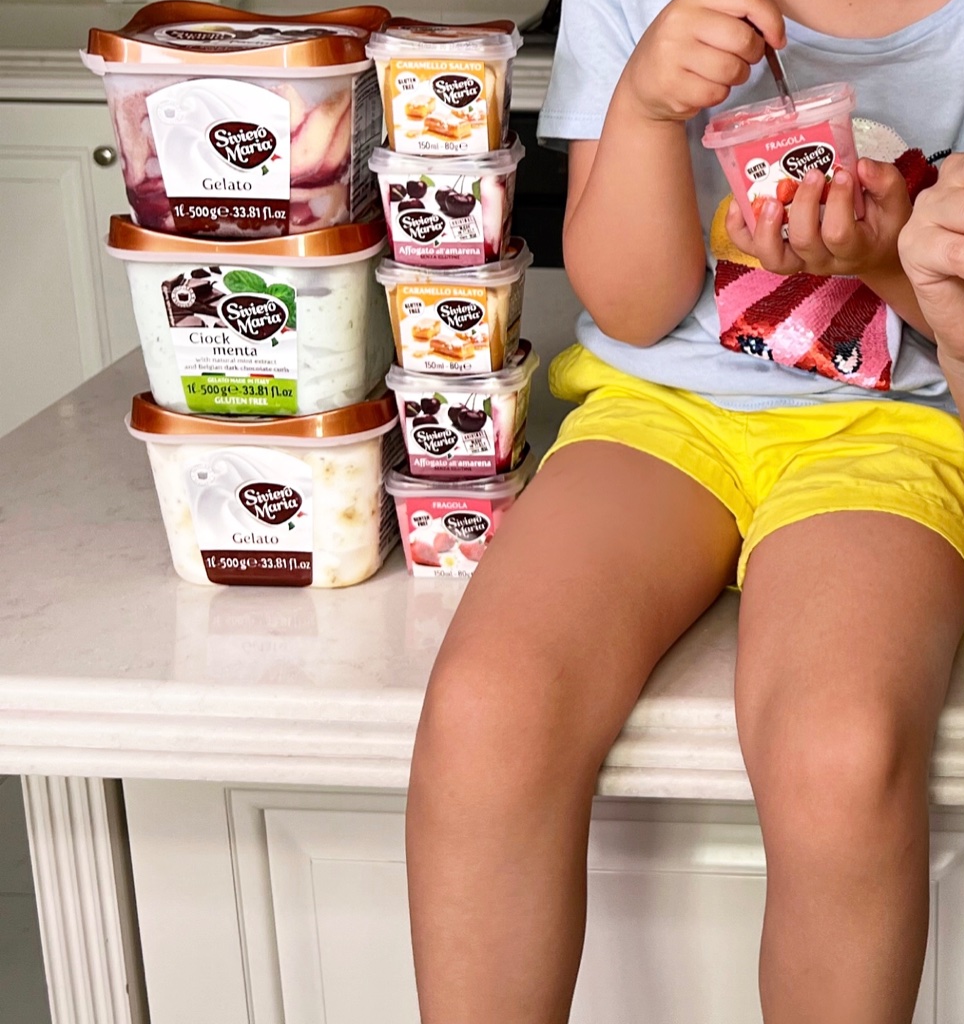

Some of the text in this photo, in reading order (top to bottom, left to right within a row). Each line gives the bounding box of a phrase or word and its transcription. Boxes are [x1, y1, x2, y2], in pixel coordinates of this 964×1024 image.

[396, 61, 482, 71] CARAMELLO SALATO
[435, 78, 474, 94] Siviero
[443, 87, 478, 104] Maria
[214, 126, 267, 147] Siviero
[765, 134, 806, 152] FRAGOLA
[225, 139, 272, 163] Maria
[786, 145, 826, 171] Siviero
[747, 161, 766, 175] GLUTEN
[753, 169, 766, 180] FREE
[202, 177, 252, 191] Gelato
[402, 215, 439, 229] Siviero
[409, 222, 443, 239] Maria
[399, 245, 435, 255] Affogato
[403, 286, 484, 296] CARAMELLO SALATO
[226, 299, 276, 320] Siviero
[440, 303, 477, 317] Siviero
[237, 312, 282, 335] Maria
[447, 311, 480, 328] Maria
[189, 332, 230, 345] Ciock
[213, 346, 258, 356] menta
[214, 396, 268, 406] GLUTEN FREE
[413, 457, 448, 467] Affogato
[244, 486, 293, 506] Siviero
[254, 498, 298, 520] Maria
[432, 501, 468, 509] FRAGOLA
[232, 532, 279, 544] Gelato
